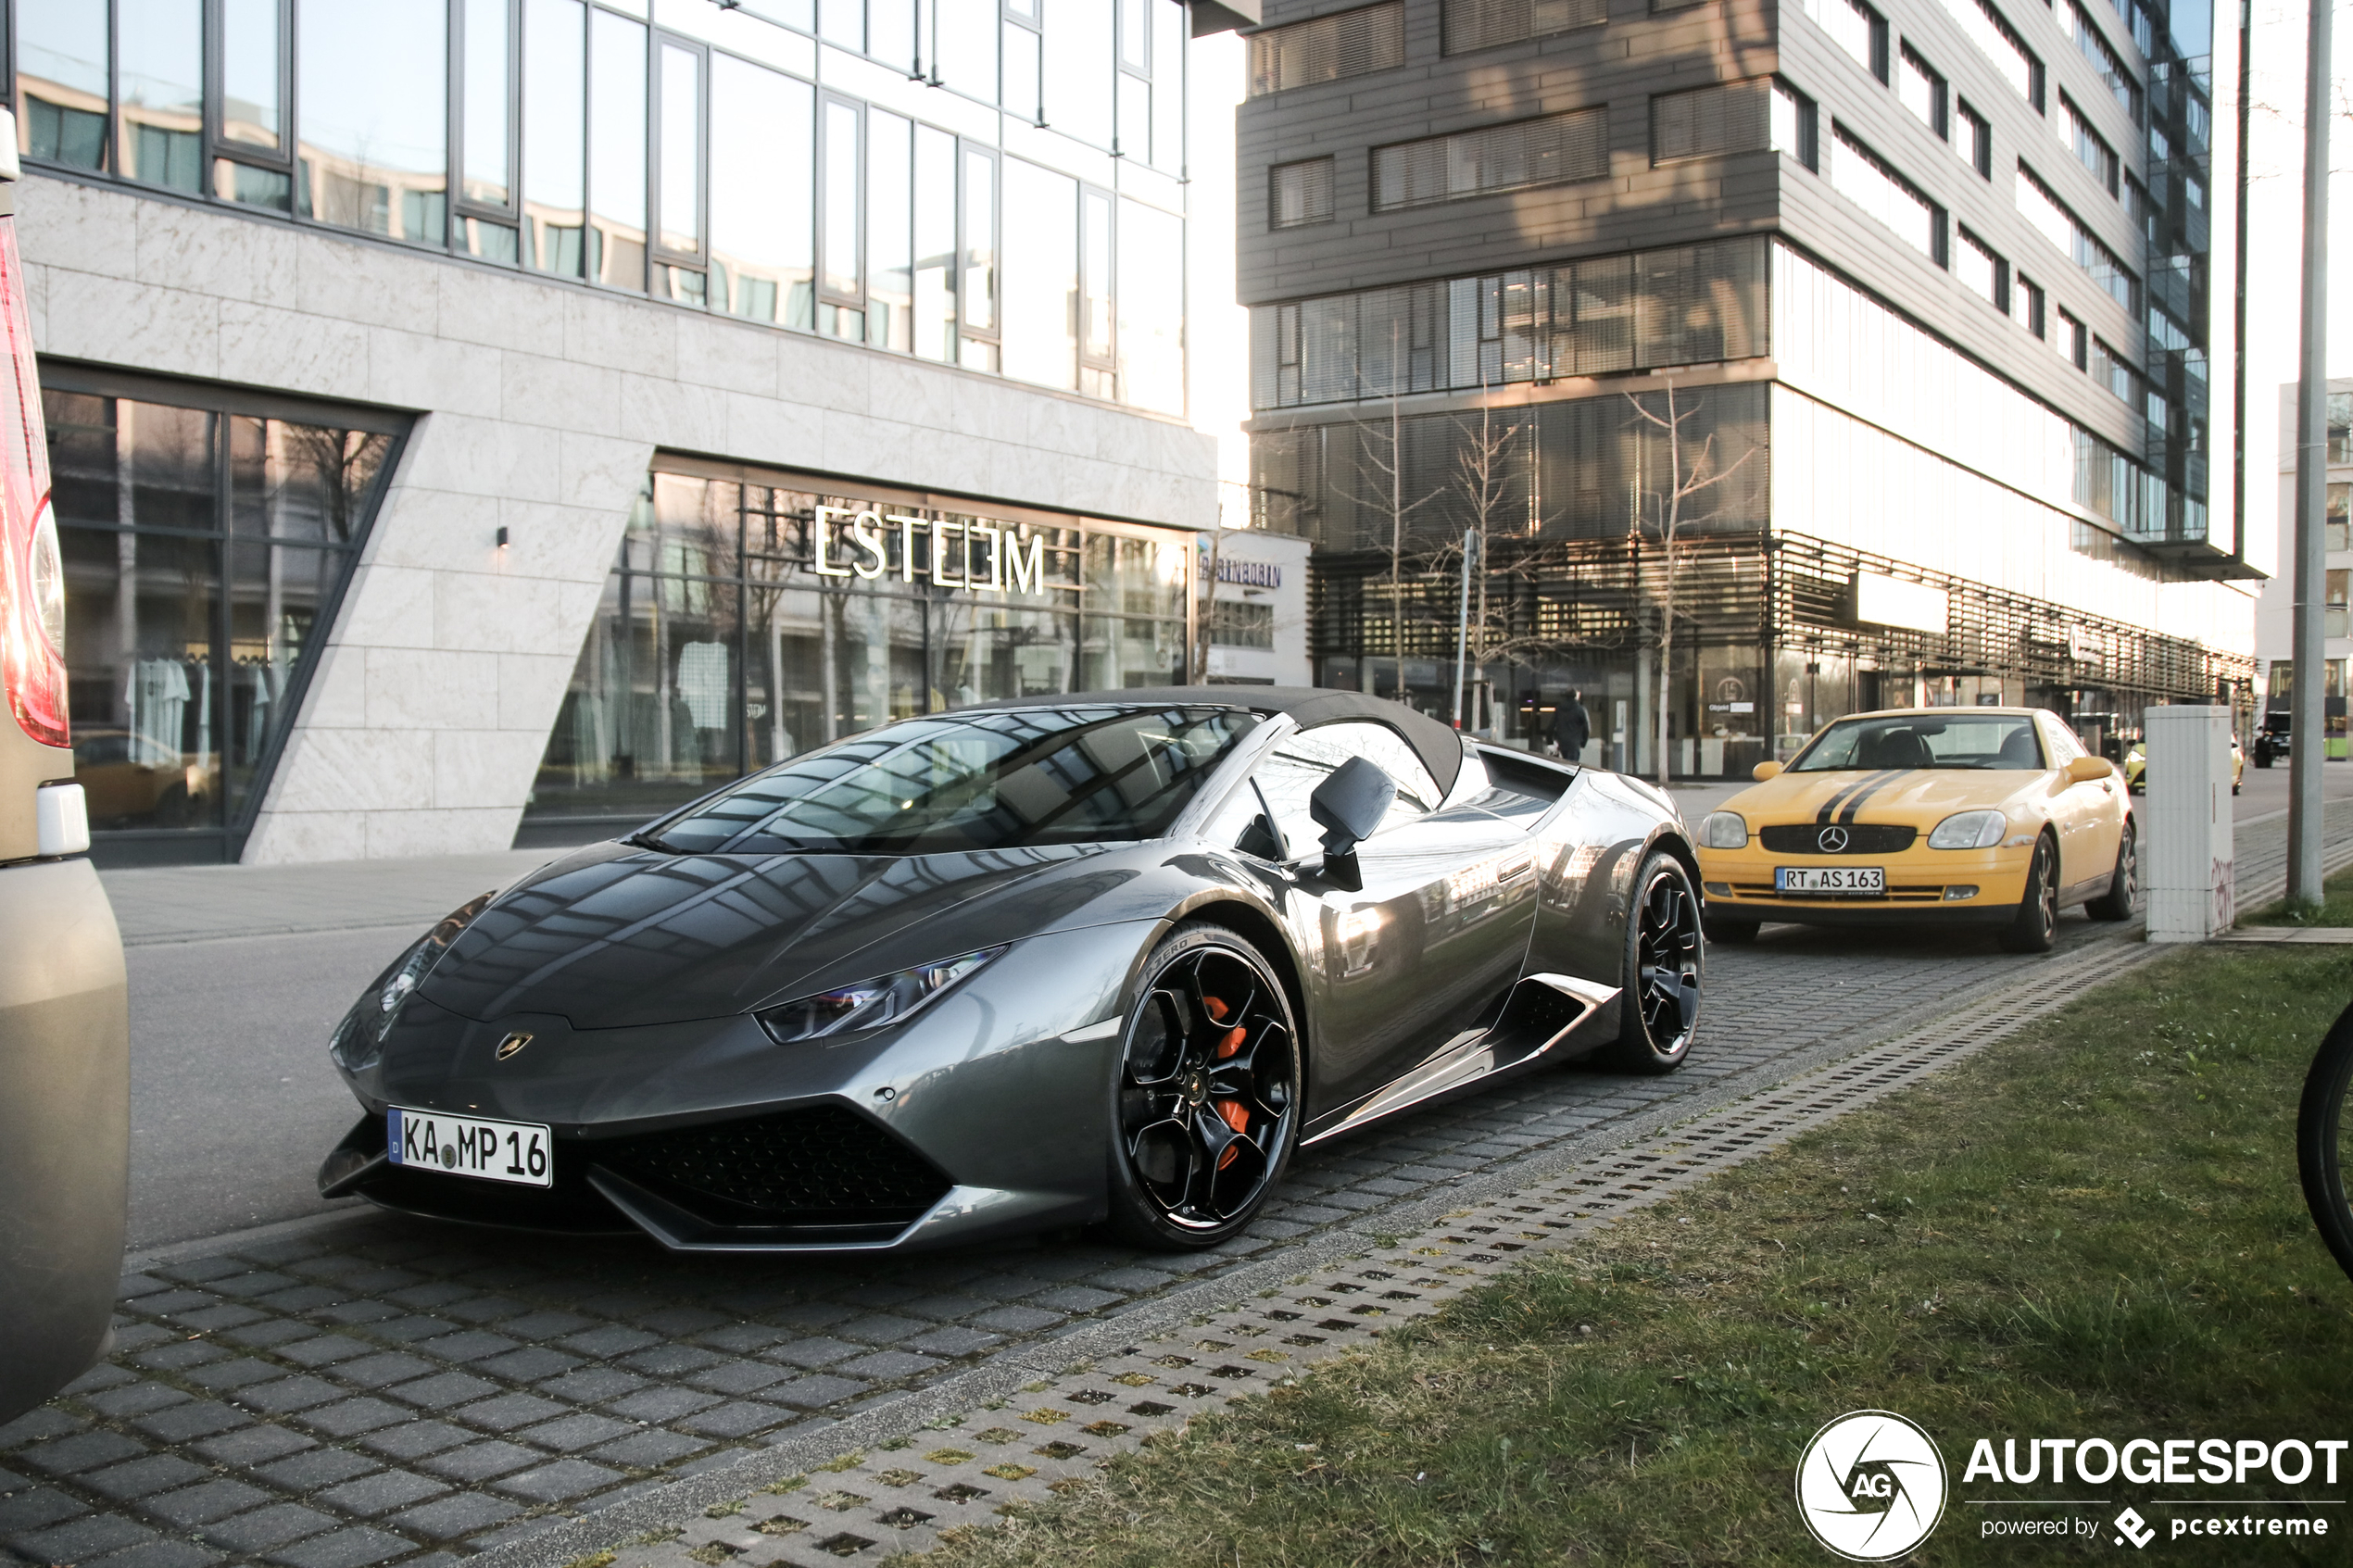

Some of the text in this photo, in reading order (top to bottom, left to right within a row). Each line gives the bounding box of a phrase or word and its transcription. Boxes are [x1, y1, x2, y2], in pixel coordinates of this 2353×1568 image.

[1786, 871, 1807, 887] RT
[1820, 871, 1843, 887] AS
[1846, 871, 1881, 887] 163
[1152, 939, 1188, 970] ZERO
[393, 1117, 547, 1177] D KA MP 16
